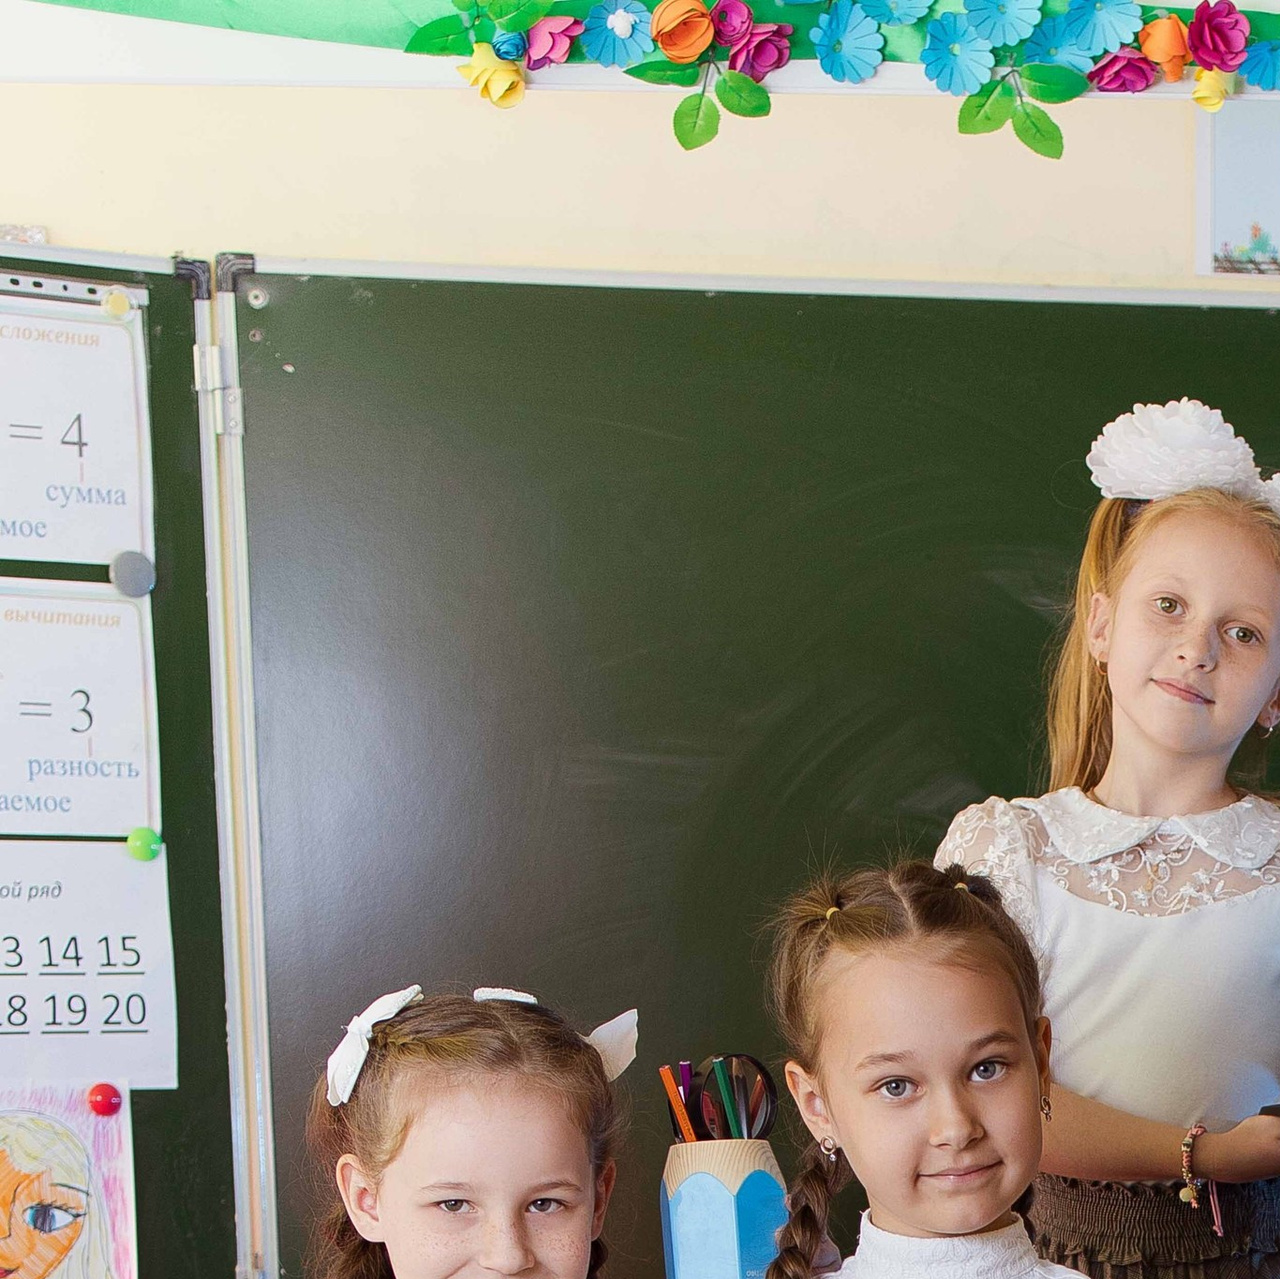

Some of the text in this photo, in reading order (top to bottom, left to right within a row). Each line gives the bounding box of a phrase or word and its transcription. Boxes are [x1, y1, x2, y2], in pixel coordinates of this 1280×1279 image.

[61, 413, 89, 458] 4
[45, 483, 128, 509] сумма
[70, 689, 94, 733] 3
[27, 757, 140, 782] разность
[27, 879, 62, 904] ряд
[38, 936, 84, 968] 14
[97, 936, 142, 968] 15
[0, 993, 148, 1027] 8 19 20
